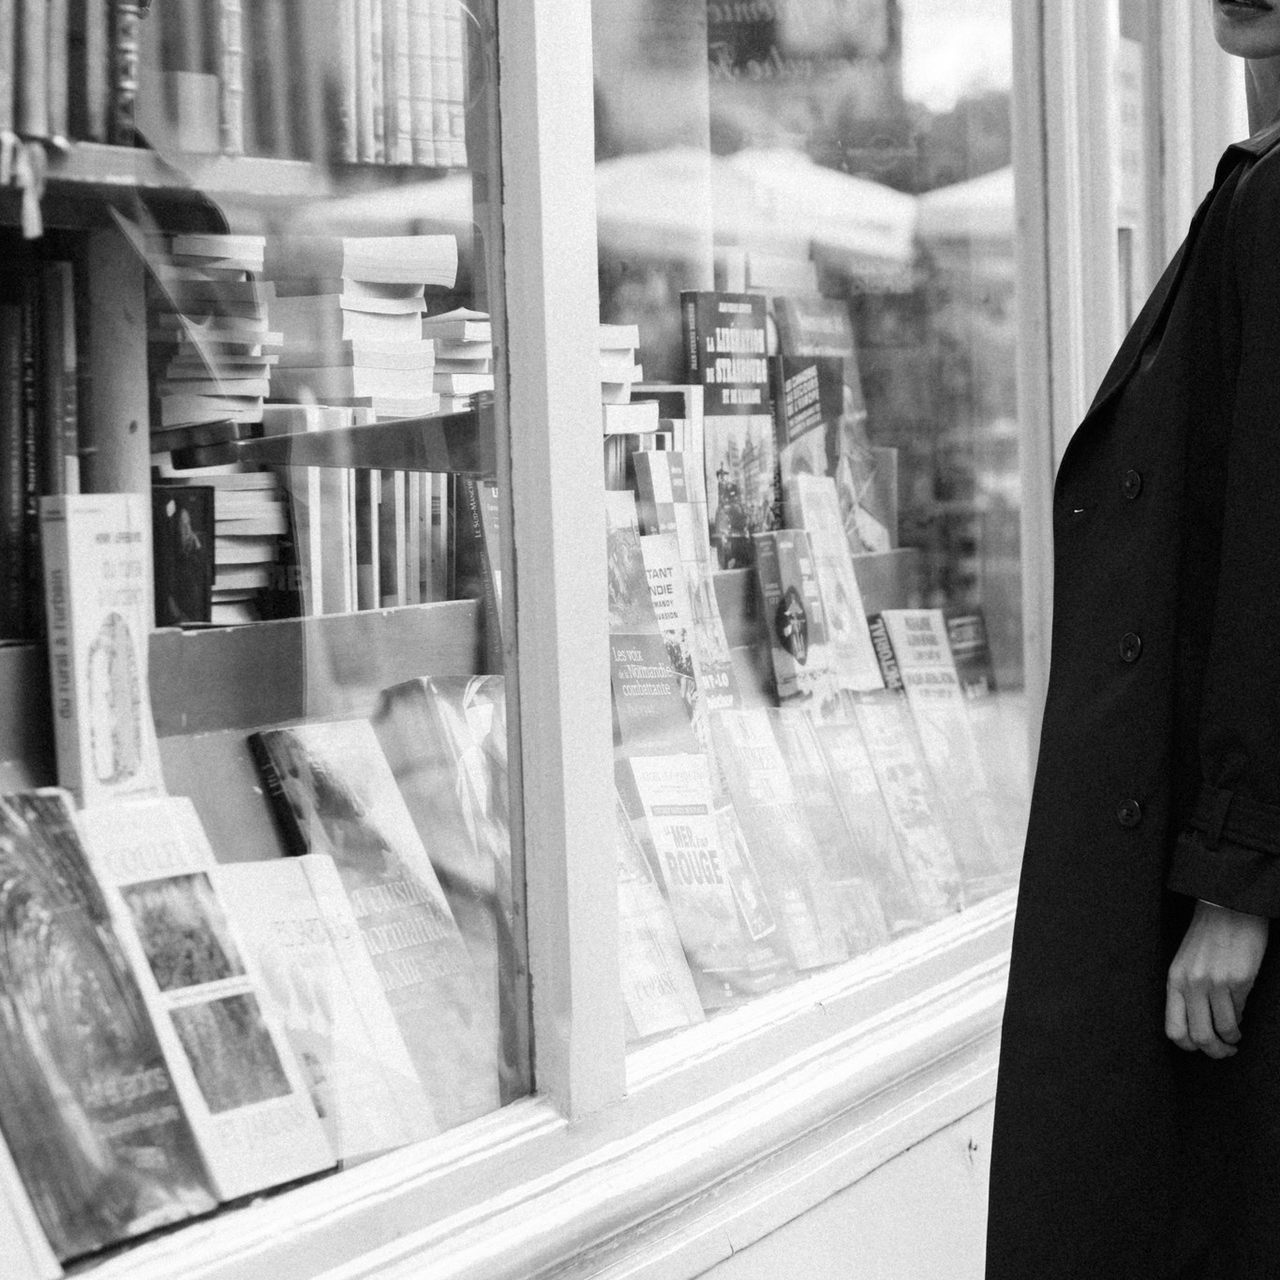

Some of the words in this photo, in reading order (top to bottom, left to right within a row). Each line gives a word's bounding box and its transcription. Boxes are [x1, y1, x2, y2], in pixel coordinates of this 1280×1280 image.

[612, 646, 627, 661] Les
[628, 647, 644, 661] voix
[664, 849, 724, 885] ROUGE
